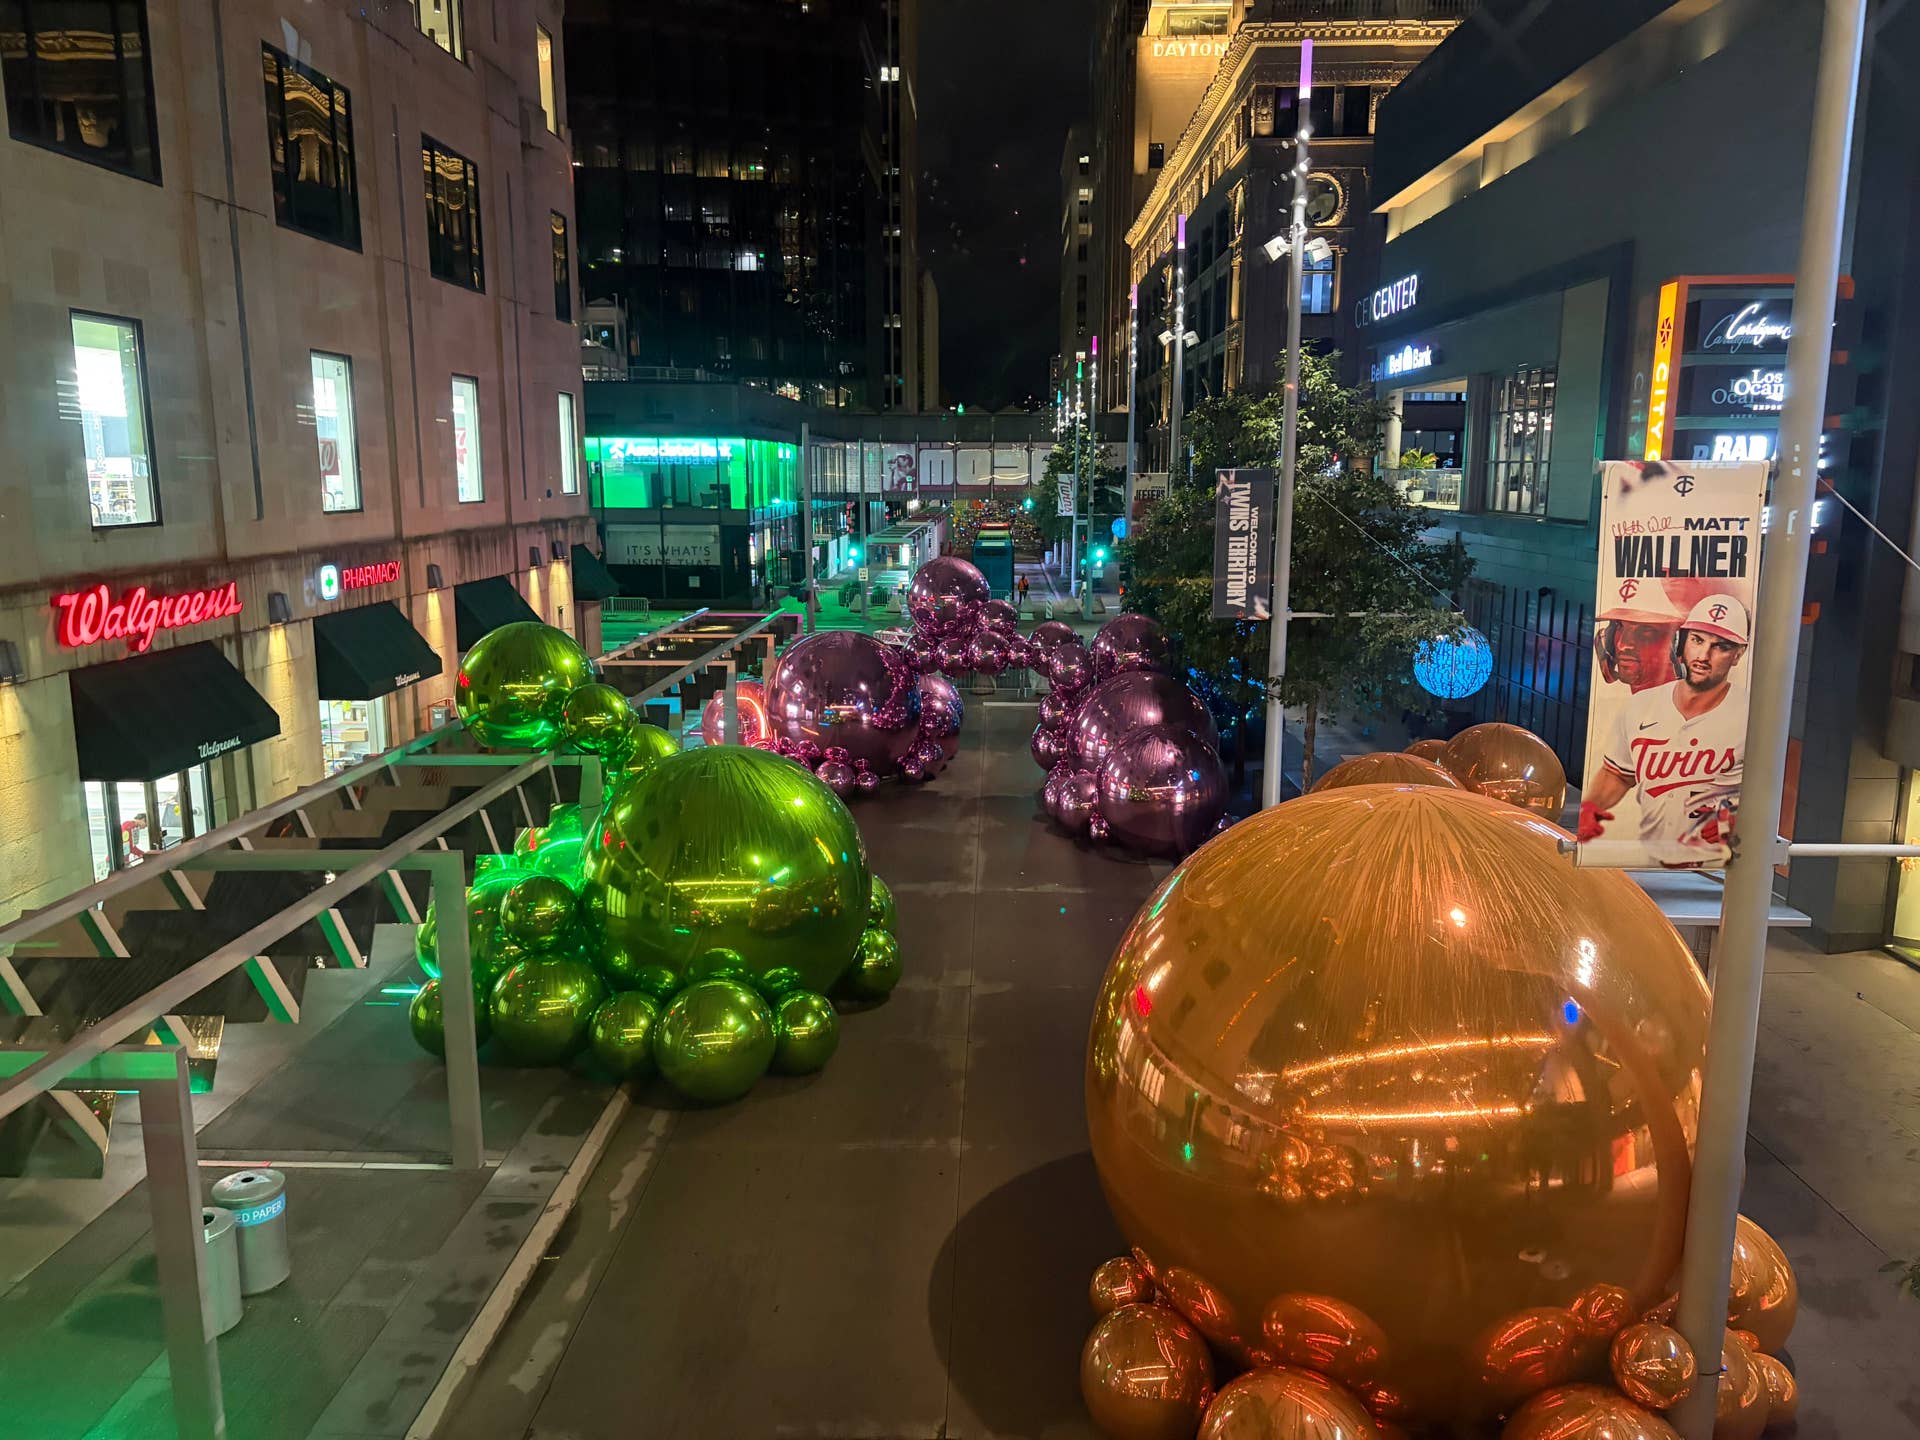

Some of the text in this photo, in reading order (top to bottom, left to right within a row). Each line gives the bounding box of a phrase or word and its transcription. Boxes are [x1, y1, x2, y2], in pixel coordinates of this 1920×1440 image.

[1373, 274, 1418, 321] CENTER
[1389, 353, 1403, 374] Bell
[1413, 345, 1432, 369] Bank
[1752, 369, 1783, 384] Los
[1651, 362, 1669, 440] CITY
[1684, 517, 1750, 531] MATT
[627, 545, 711, 556] IT'S WHAT'S
[1226, 482, 1251, 608] TWINS TERRITORY
[1248, 507, 1259, 585] WELCOME TO
[1615, 535, 1748, 578] WALLNER
[342, 560, 401, 591] PHARMACY
[57, 582, 243, 652] Walgreens
[198, 736, 241, 758] Walgreens
[1630, 738, 1736, 785] Twins
[252, 1201, 282, 1221] PAPER
